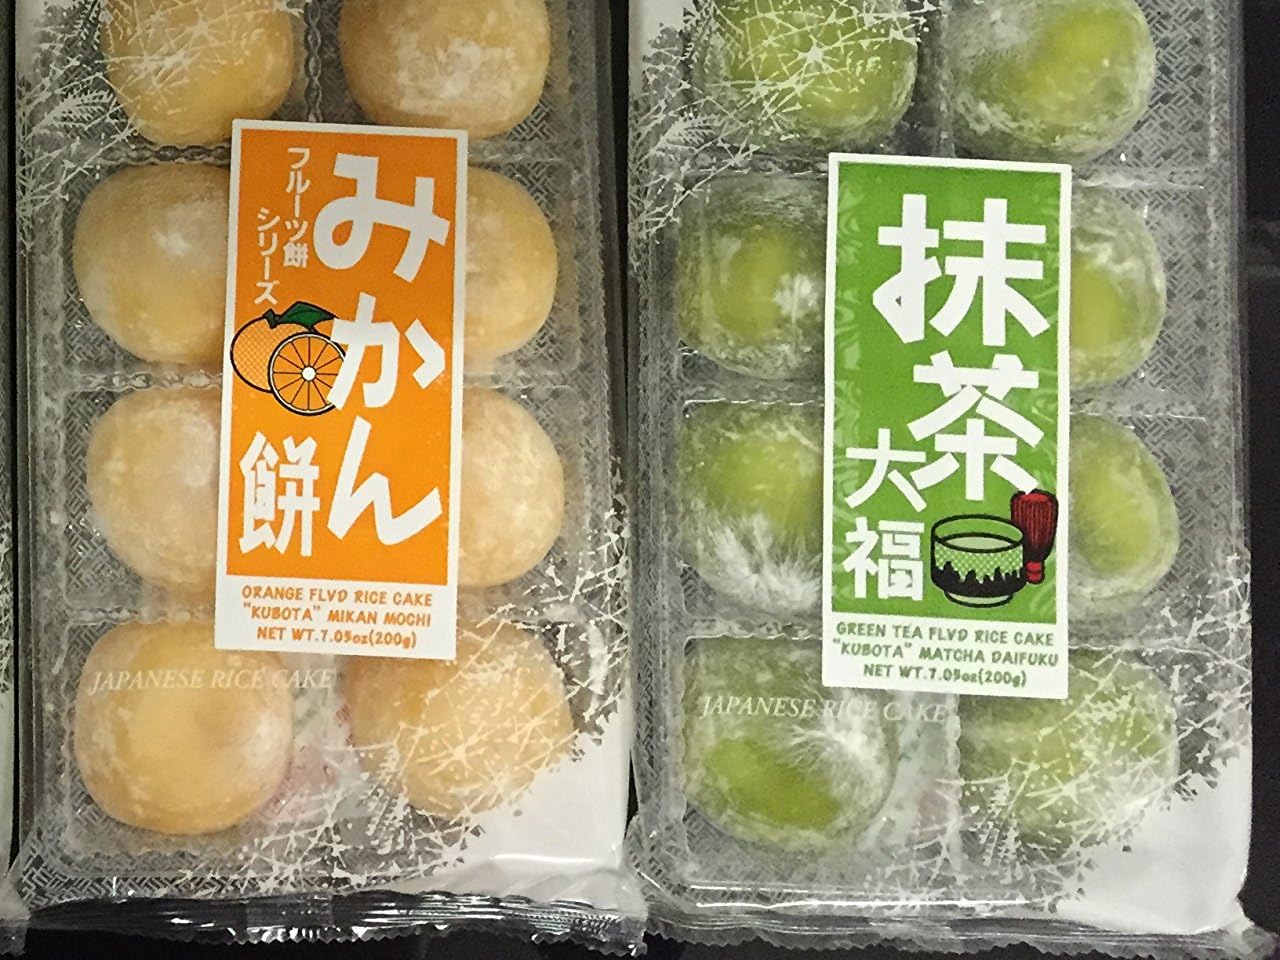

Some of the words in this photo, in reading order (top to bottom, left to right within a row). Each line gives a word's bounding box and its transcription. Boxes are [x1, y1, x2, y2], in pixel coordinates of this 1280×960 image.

[254, 207, 280, 305] シリーズ
[312, 152, 451, 546] みかん
[873, 193, 1051, 501] 抹茶
[239, 430, 320, 557] 餅
[842, 427, 927, 601] 大福
[242, 584, 304, 601] ORANGE
[309, 587, 348, 603] FLVD
[354, 590, 387, 605] RICE
[393, 591, 433, 607] CAKE
[327, 609, 377, 625] MIKAN
[384, 611, 431, 627] MOCHI
[257, 626, 287, 640] NET
[836, 621, 886, 637] GREEN
[892, 624, 923, 639] TEA
[928, 627, 968, 642] FLVD
[974, 630, 1008, 644] RICE
[1014, 631, 1054, 647] CAKE
[863, 663, 893, 677] NET
[919, 646, 985, 663] MATCHA
[992, 650, 1059, 667] DAIFUKU
[88, 669, 204, 696] JAPANESE
[211, 668, 267, 689] RICE
[271, 669, 336, 689] CAKE
[699, 696, 817, 719] JAPANESE
[822, 698, 878, 720] RICE
[883, 701, 951, 723] CAKE
